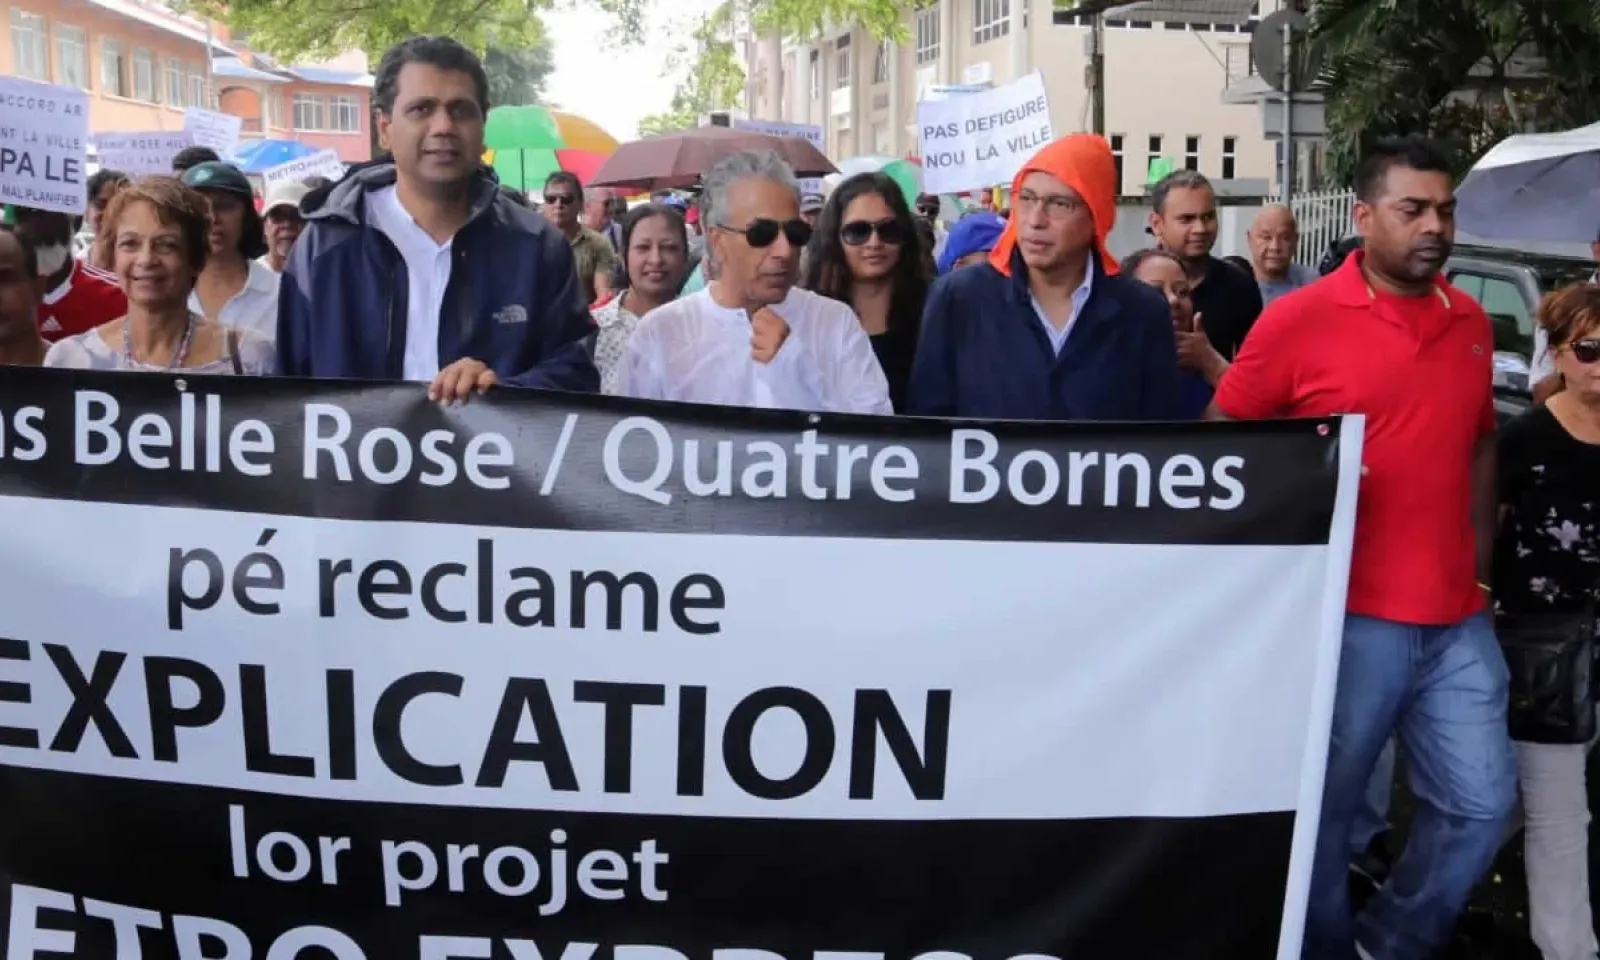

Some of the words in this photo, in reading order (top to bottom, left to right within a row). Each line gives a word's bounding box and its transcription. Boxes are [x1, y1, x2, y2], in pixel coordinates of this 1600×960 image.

[1, 147, 35, 178] PA
[45, 155, 79, 185] LE
[924, 123, 959, 140] PAS
[965, 96, 1046, 135] DEFIGURE
[926, 150, 965, 168] NOU
[975, 144, 999, 160] LA
[1007, 125, 1050, 153] VILLE
[0, 406, 47, 461] s
[75, 390, 275, 476] Belle
[303, 402, 514, 491] Rose
[539, 414, 578, 496] /
[602, 415, 919, 505] Quatre
[949, 428, 1246, 511] Bornes
[167, 528, 286, 631] pé
[318, 538, 726, 634] reclame
[0, 637, 952, 801] EXPLICATION
[229, 804, 351, 885] lor
[380, 828, 670, 916] projet
